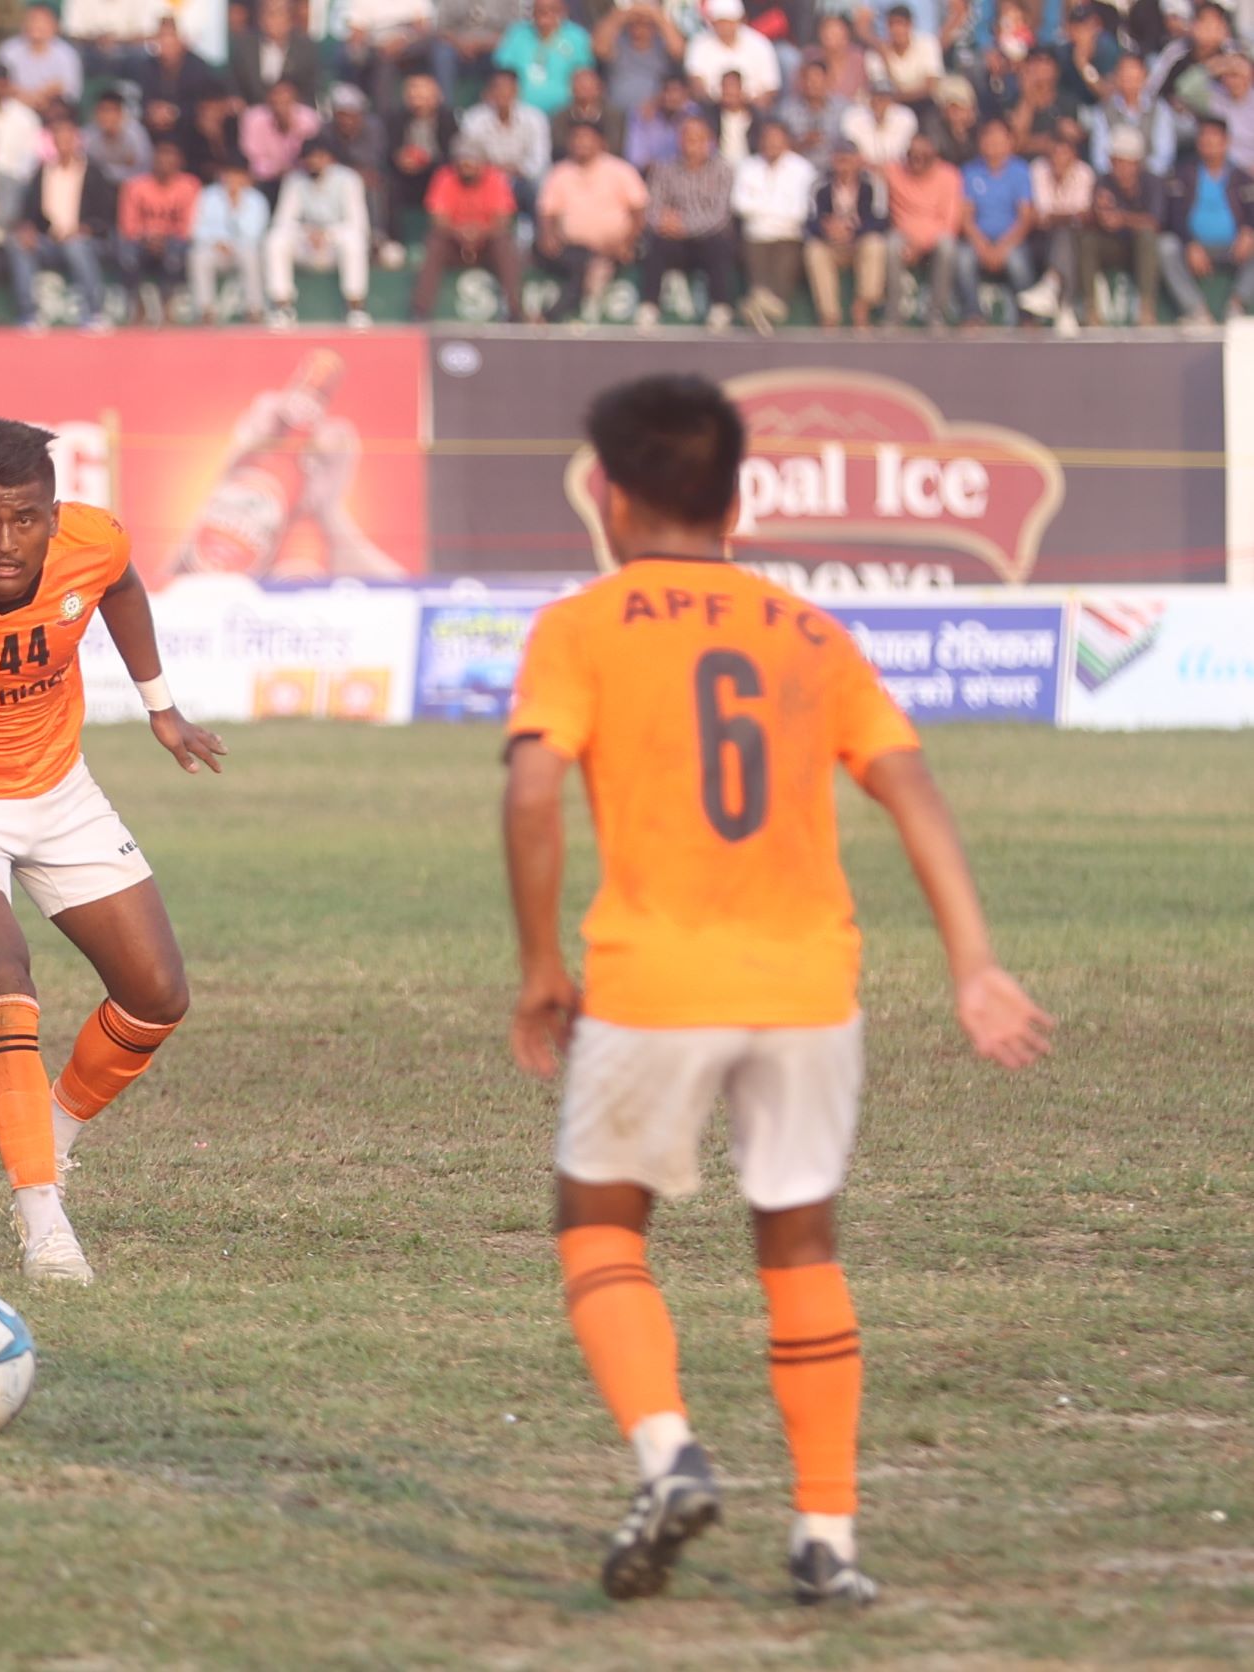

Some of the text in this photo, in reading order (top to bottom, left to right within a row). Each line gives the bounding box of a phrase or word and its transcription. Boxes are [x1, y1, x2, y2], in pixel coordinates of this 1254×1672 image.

[874, 443, 990, 519] Ice
[623, 588, 827, 646] APF FC
[694, 646, 770, 844] 6
